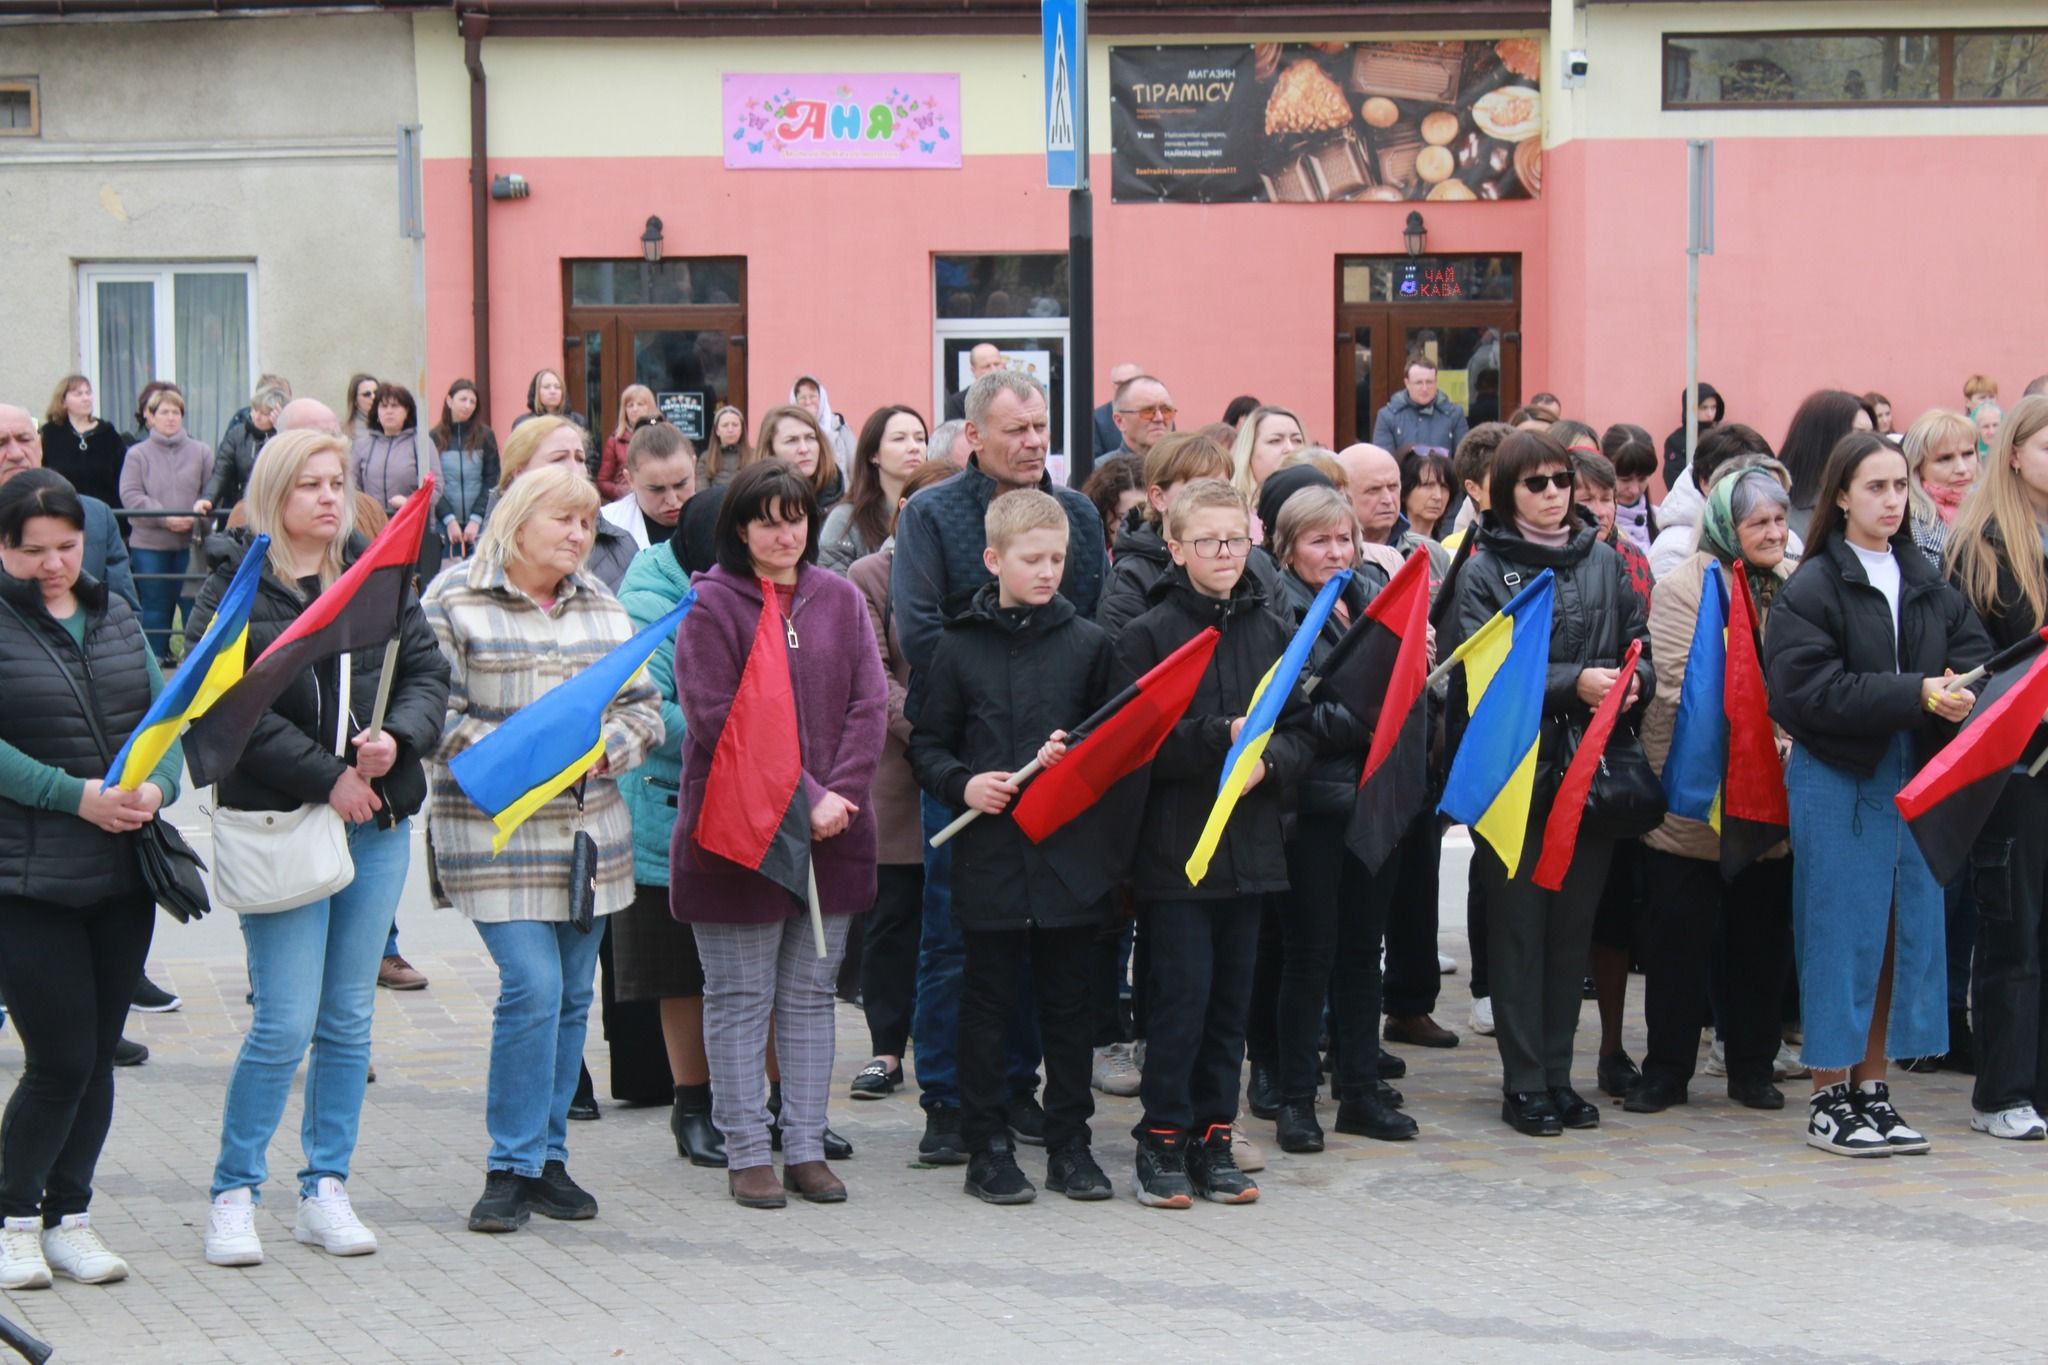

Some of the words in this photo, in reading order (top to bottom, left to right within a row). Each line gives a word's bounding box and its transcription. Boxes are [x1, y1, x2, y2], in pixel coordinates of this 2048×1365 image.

[1187, 69, 1236, 80] МАГАЗИН
[1132, 82, 1234, 103] ТІРАМІСУ
[777, 100, 895, 141] АНЯ
[1424, 265, 1455, 282] ЧАЙ
[1420, 283, 1463, 297] КАВА
